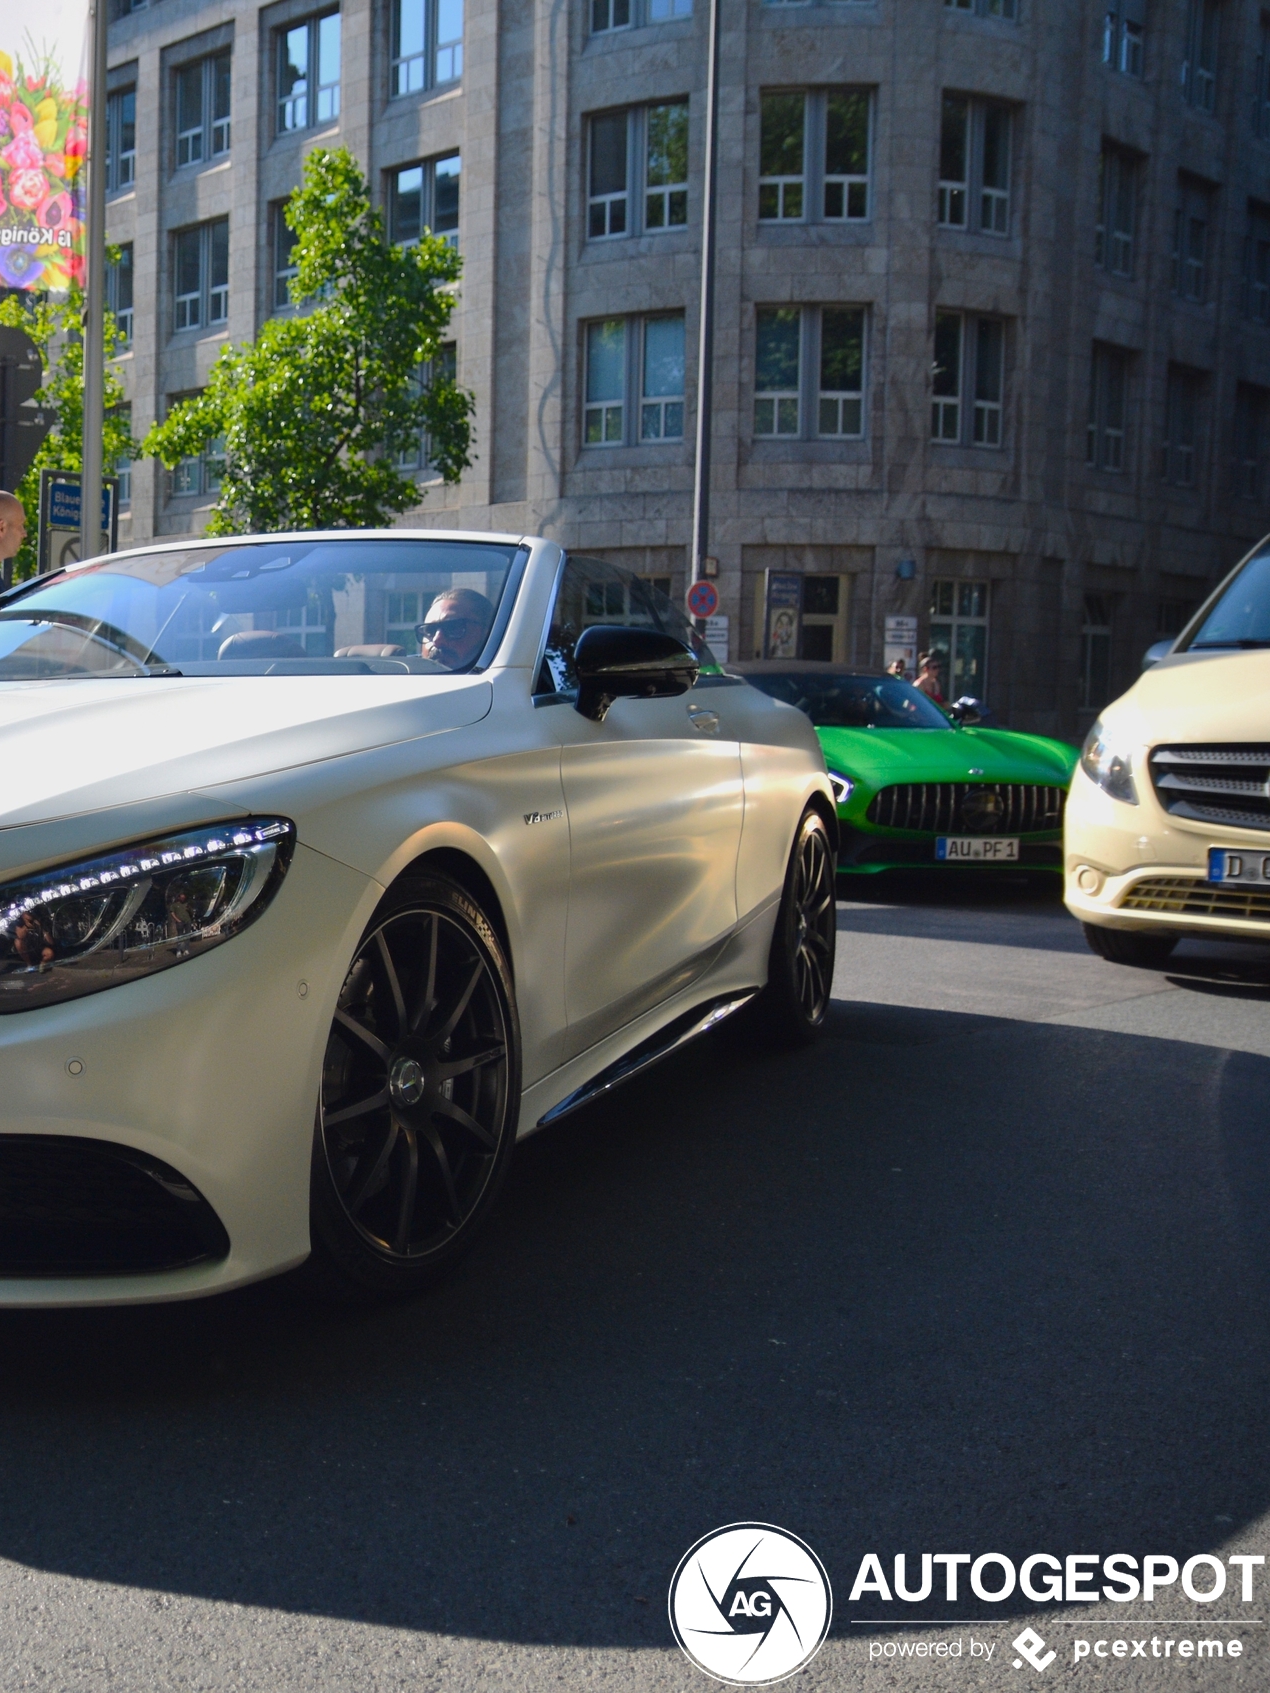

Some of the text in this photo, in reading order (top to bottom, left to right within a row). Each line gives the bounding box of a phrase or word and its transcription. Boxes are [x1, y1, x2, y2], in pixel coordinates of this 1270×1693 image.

[949, 840, 971, 857] AU
[983, 841, 1003, 857] PF
[1006, 841, 1016, 857] 1
[1226, 855, 1242, 877] D
